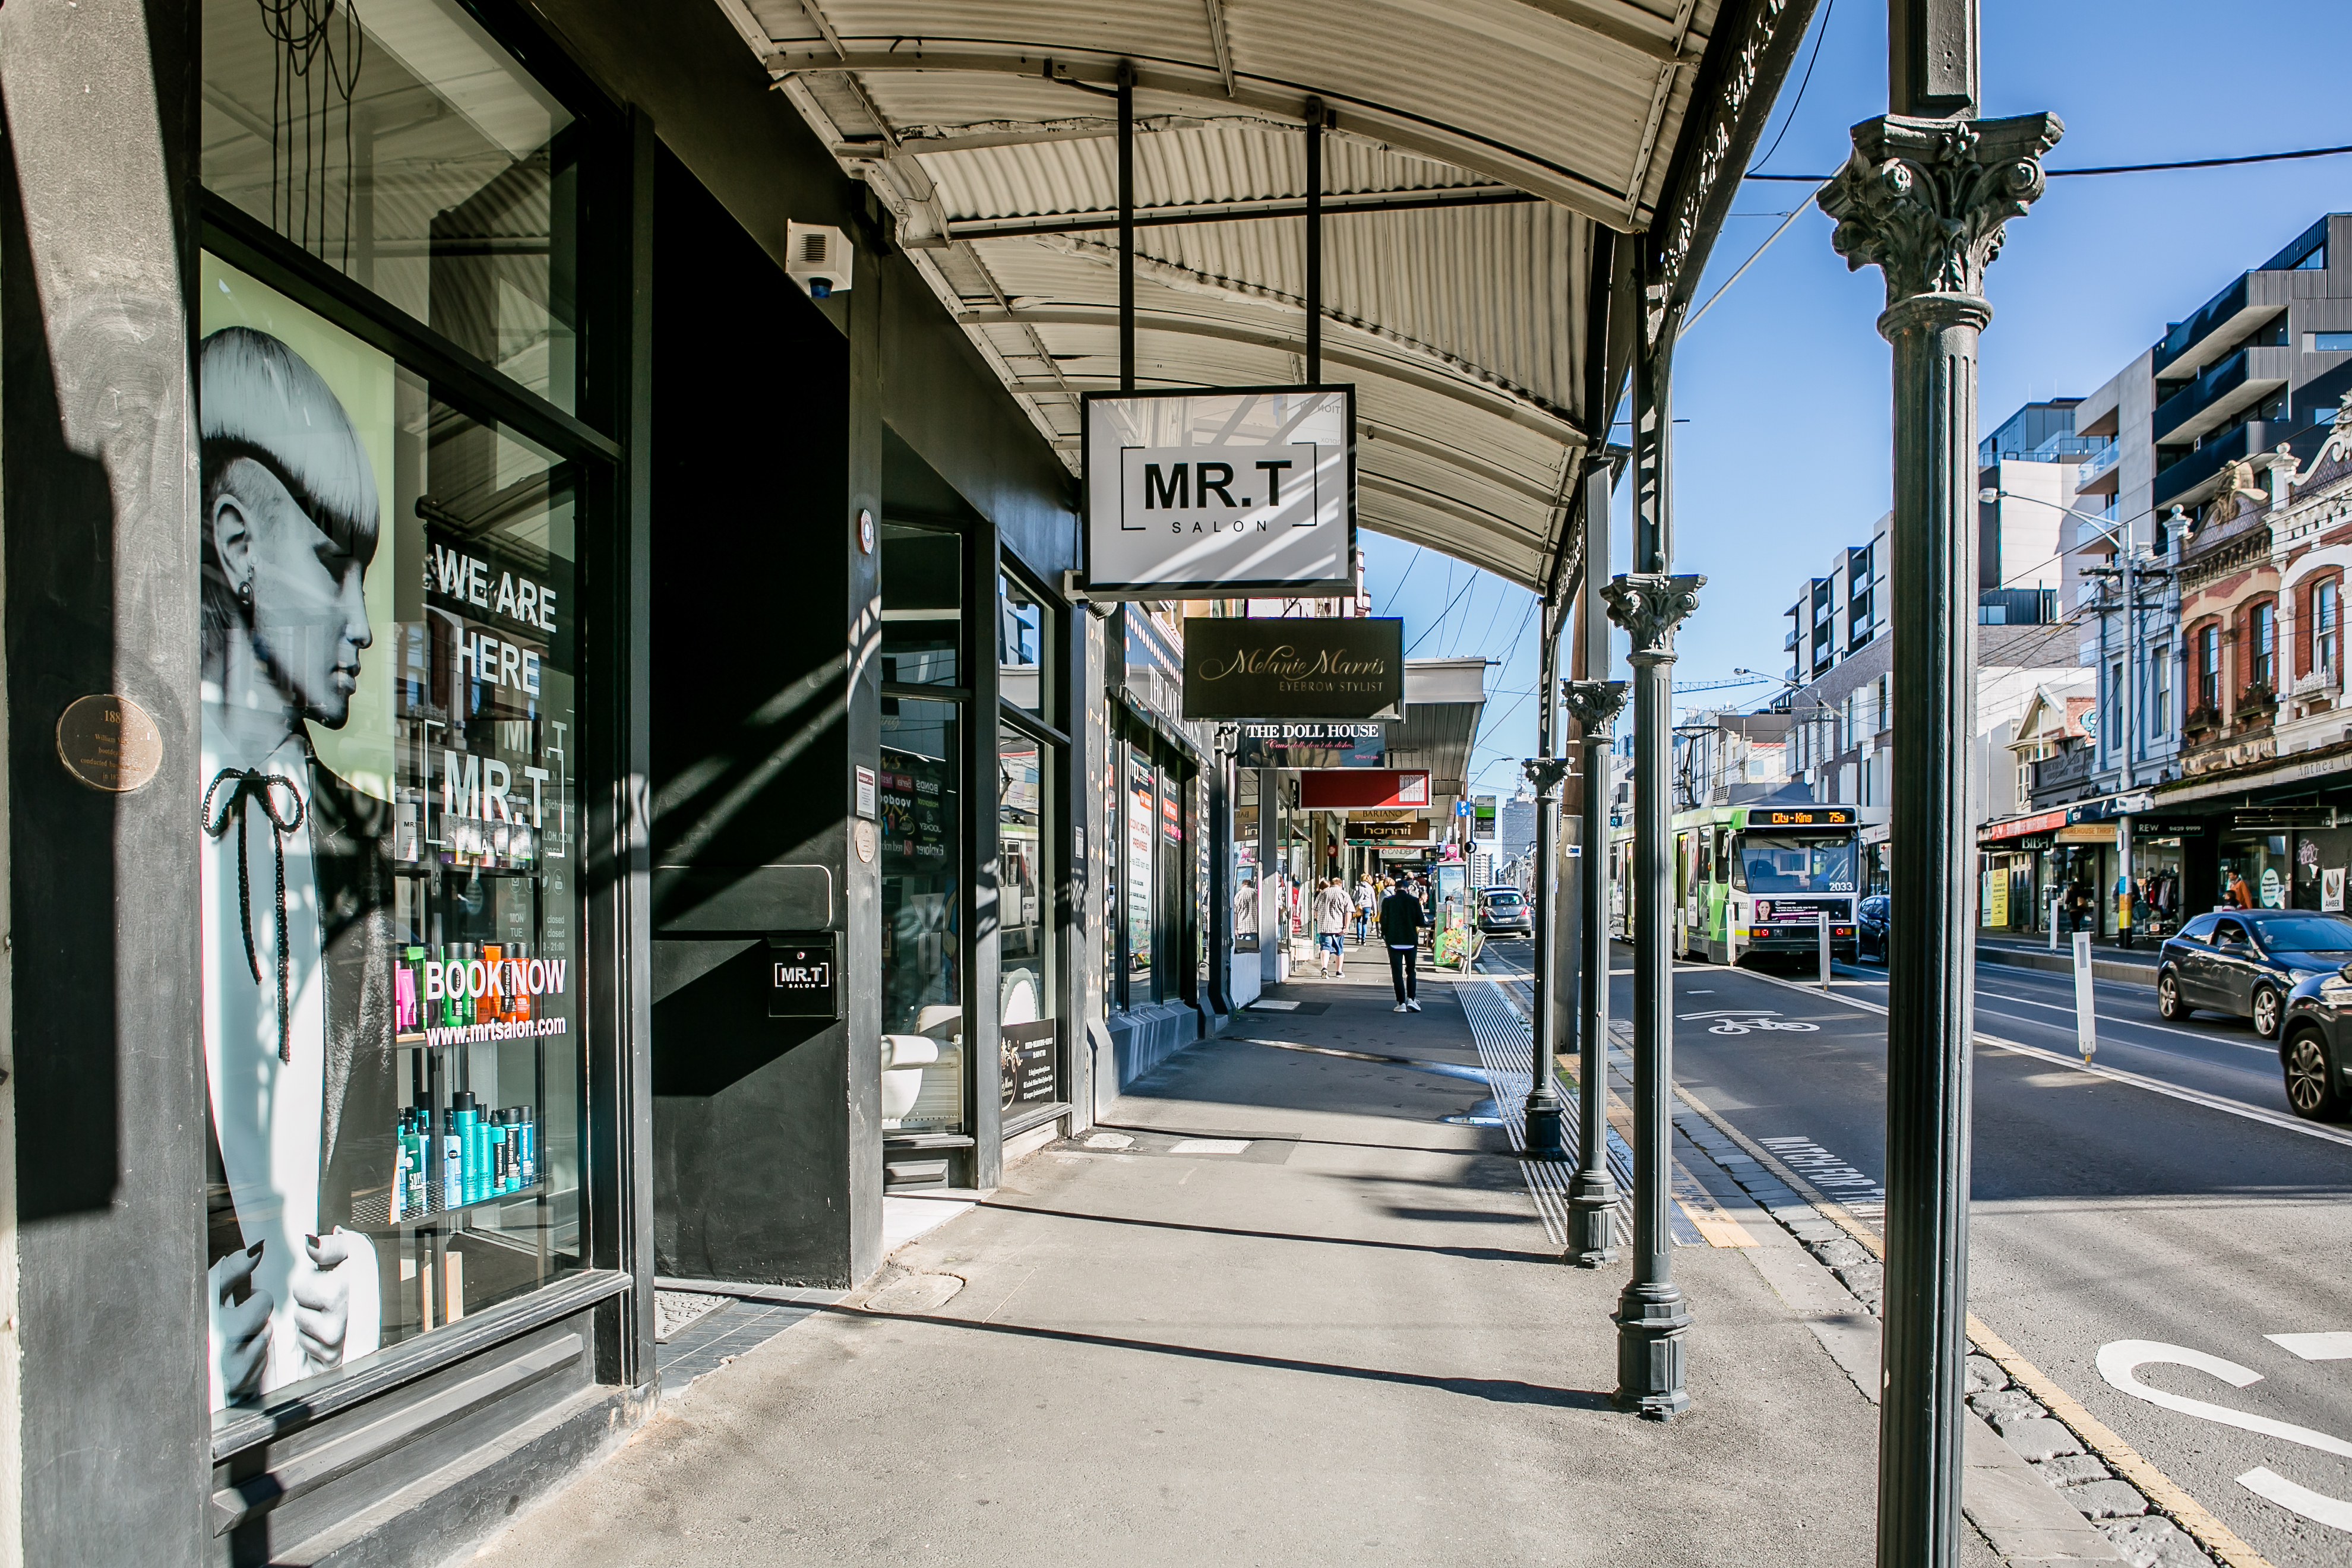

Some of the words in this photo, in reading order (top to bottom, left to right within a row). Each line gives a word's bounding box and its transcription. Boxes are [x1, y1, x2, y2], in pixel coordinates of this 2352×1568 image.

[1145, 460, 1292, 510] MR.T
[1172, 520, 1267, 533] SALON
[435, 543, 488, 608] WE
[496, 571, 556, 633] ARE
[457, 627, 539, 696] HERE
[1199, 645, 1307, 680] Melanie
[1148, 663, 1164, 713] THE
[1279, 682, 1334, 691] EYEBROW
[1339, 681, 1383, 691] STYLIST
[1247, 724, 1279, 738] THE
[1282, 724, 1324, 738] DOLL
[1327, 724, 1379, 738] HOUSE
[444, 749, 549, 828] MR.T
[1772, 813, 1789, 823] City
[1795, 812, 1812, 823] King
[1829, 812, 1845, 823] 75a
[2022, 837, 2048, 849] BIBA
[1829, 882, 1853, 891] 2033
[2325, 899, 2340, 908] AMBER
[510, 913, 524, 923] MON
[547, 915, 564, 924] closed
[510, 928, 523, 937] TUE
[547, 928, 564, 937] closed
[551, 942, 565, 951] 21:00
[426, 960, 504, 1000] BOOK
[512, 959, 566, 995] NOW
[781, 968, 822, 982] MR.T
[426, 1016, 566, 1047] www.mrtsalon.com
[1757, 1136, 1848, 1167] WATCH
[1798, 1168, 1877, 1187] FOR
